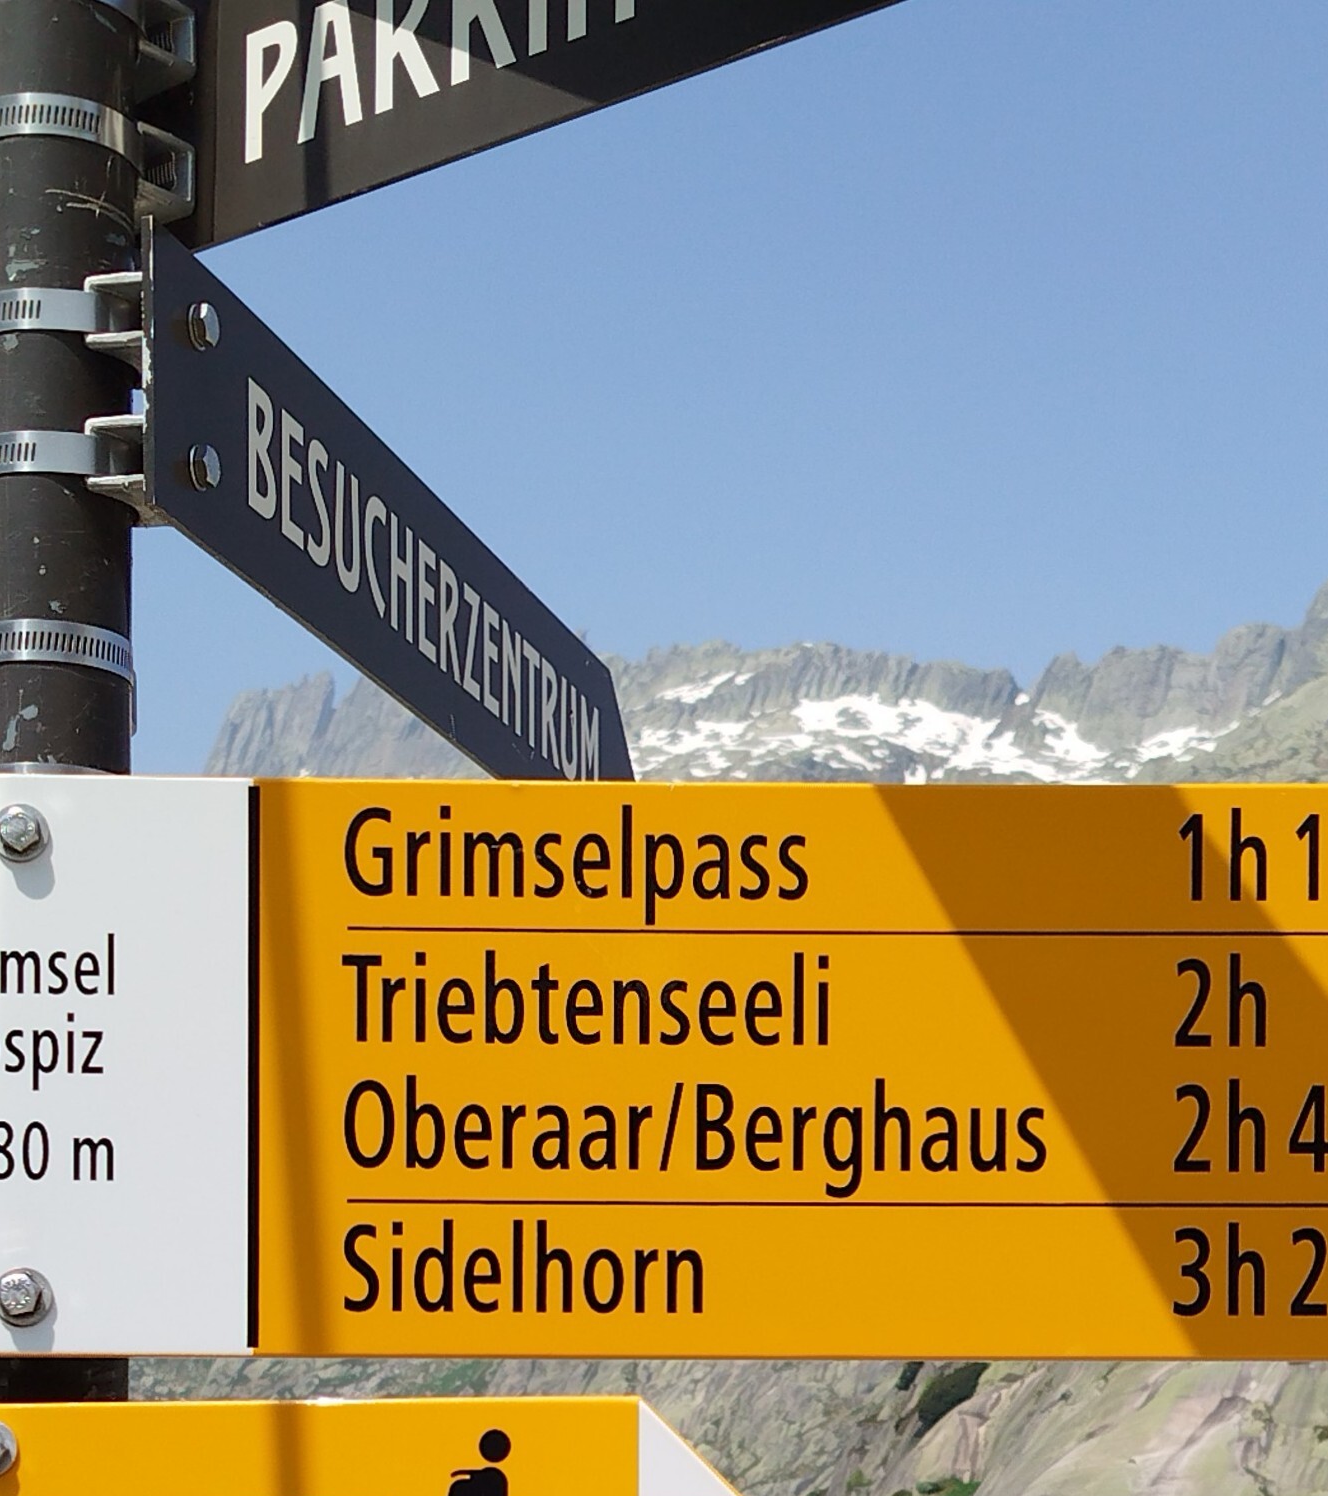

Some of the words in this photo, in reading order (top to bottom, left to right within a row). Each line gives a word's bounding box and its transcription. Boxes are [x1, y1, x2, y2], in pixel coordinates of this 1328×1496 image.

[248, 376, 600, 781] BESUCHERZENTRUM
[344, 804, 808, 925] Grimselpass
[342, 950, 828, 1046] Triebtenseeli
[73, 1137, 114, 1181] m
[344, 1075, 1046, 1196] Oberaar/Berghaus
[344, 1219, 703, 1313] Sidelhorn
